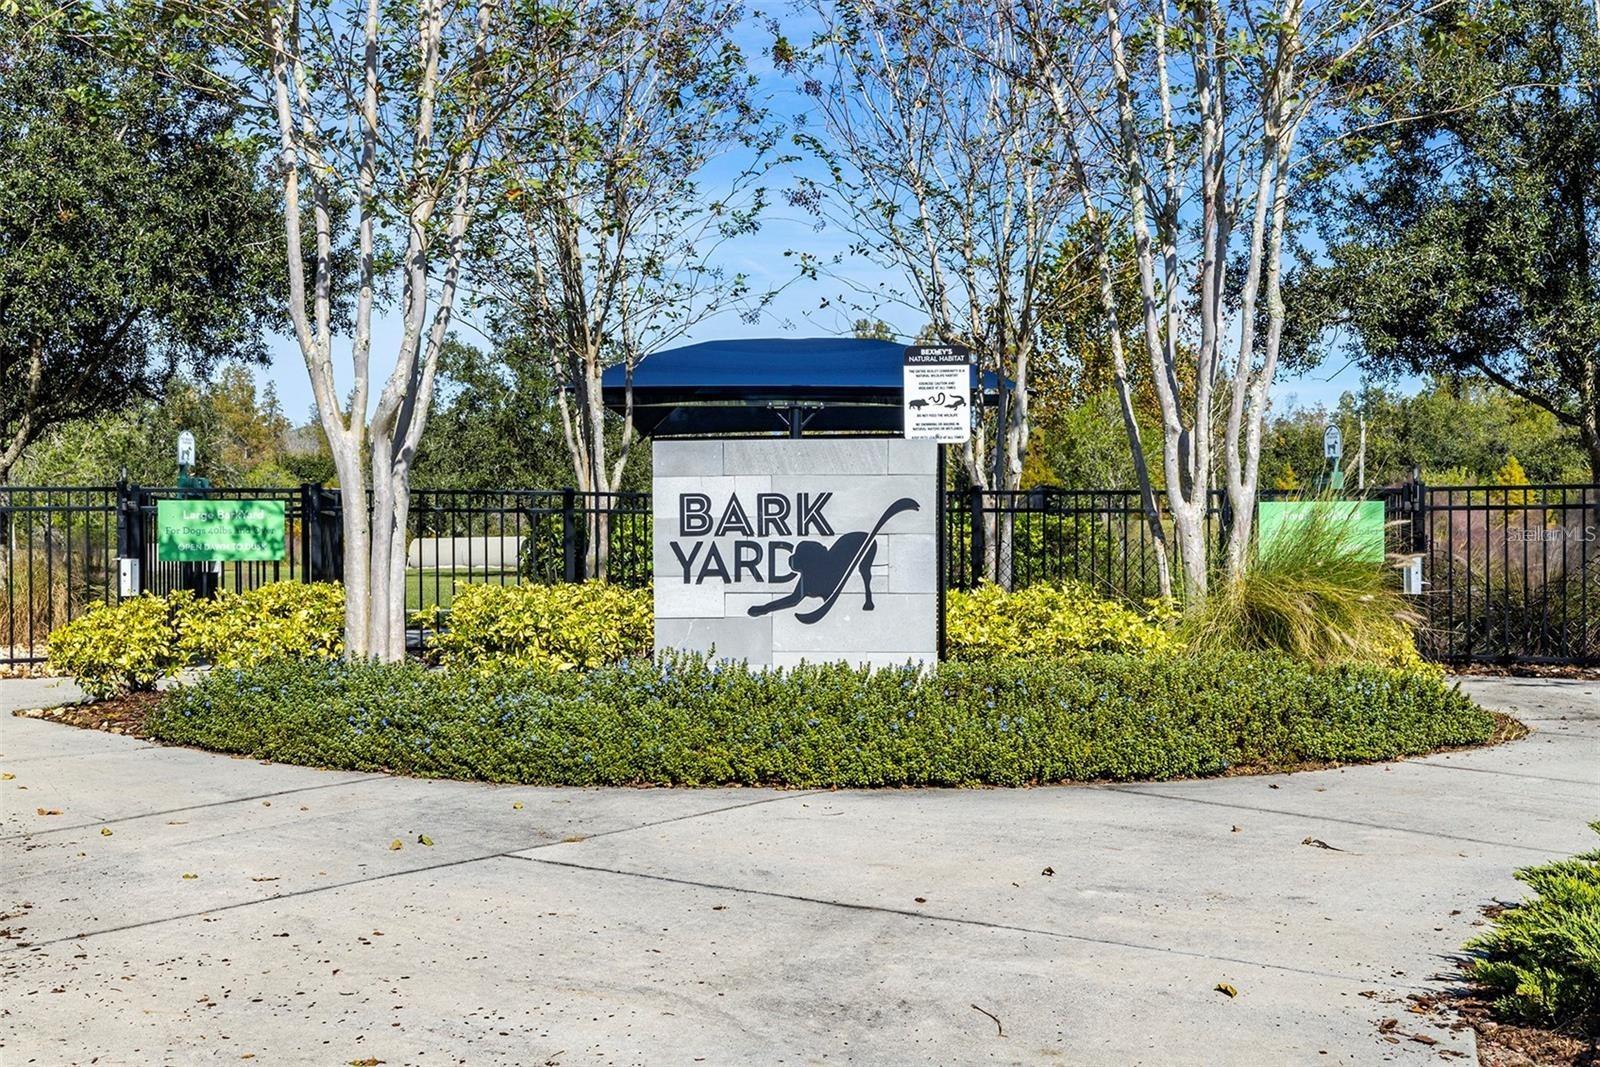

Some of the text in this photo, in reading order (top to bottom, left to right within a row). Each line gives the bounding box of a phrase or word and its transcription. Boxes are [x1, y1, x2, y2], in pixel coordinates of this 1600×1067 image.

[183, 509, 264, 522] Large BarkYard
[679, 492, 835, 537] BARK
[165, 526, 180, 535] For
[183, 526, 206, 536] Dogs
[670, 540, 798, 584] YARD
